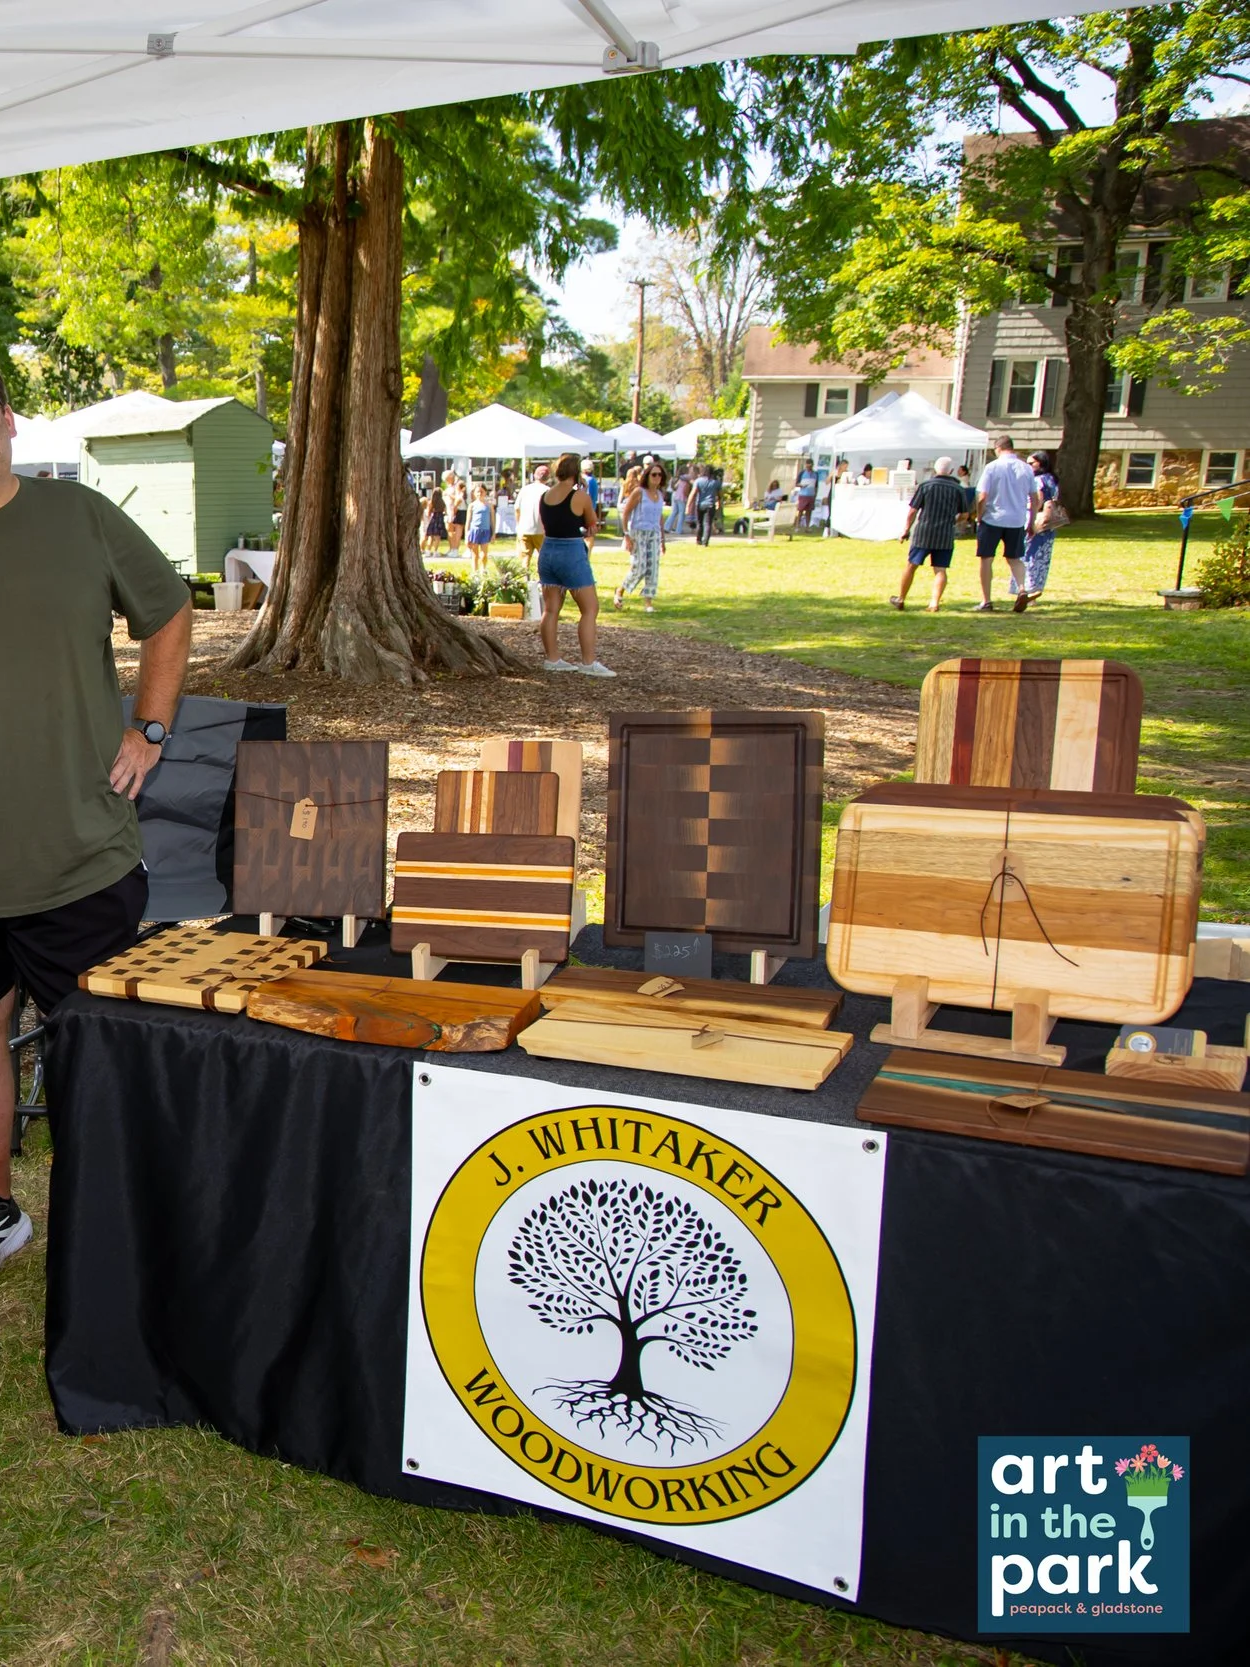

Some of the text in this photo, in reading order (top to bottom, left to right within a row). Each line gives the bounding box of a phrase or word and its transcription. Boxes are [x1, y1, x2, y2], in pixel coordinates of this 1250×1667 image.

[492, 1116, 783, 1227] J. WHITAKER
[462, 1367, 798, 1513] WOODWORKING
